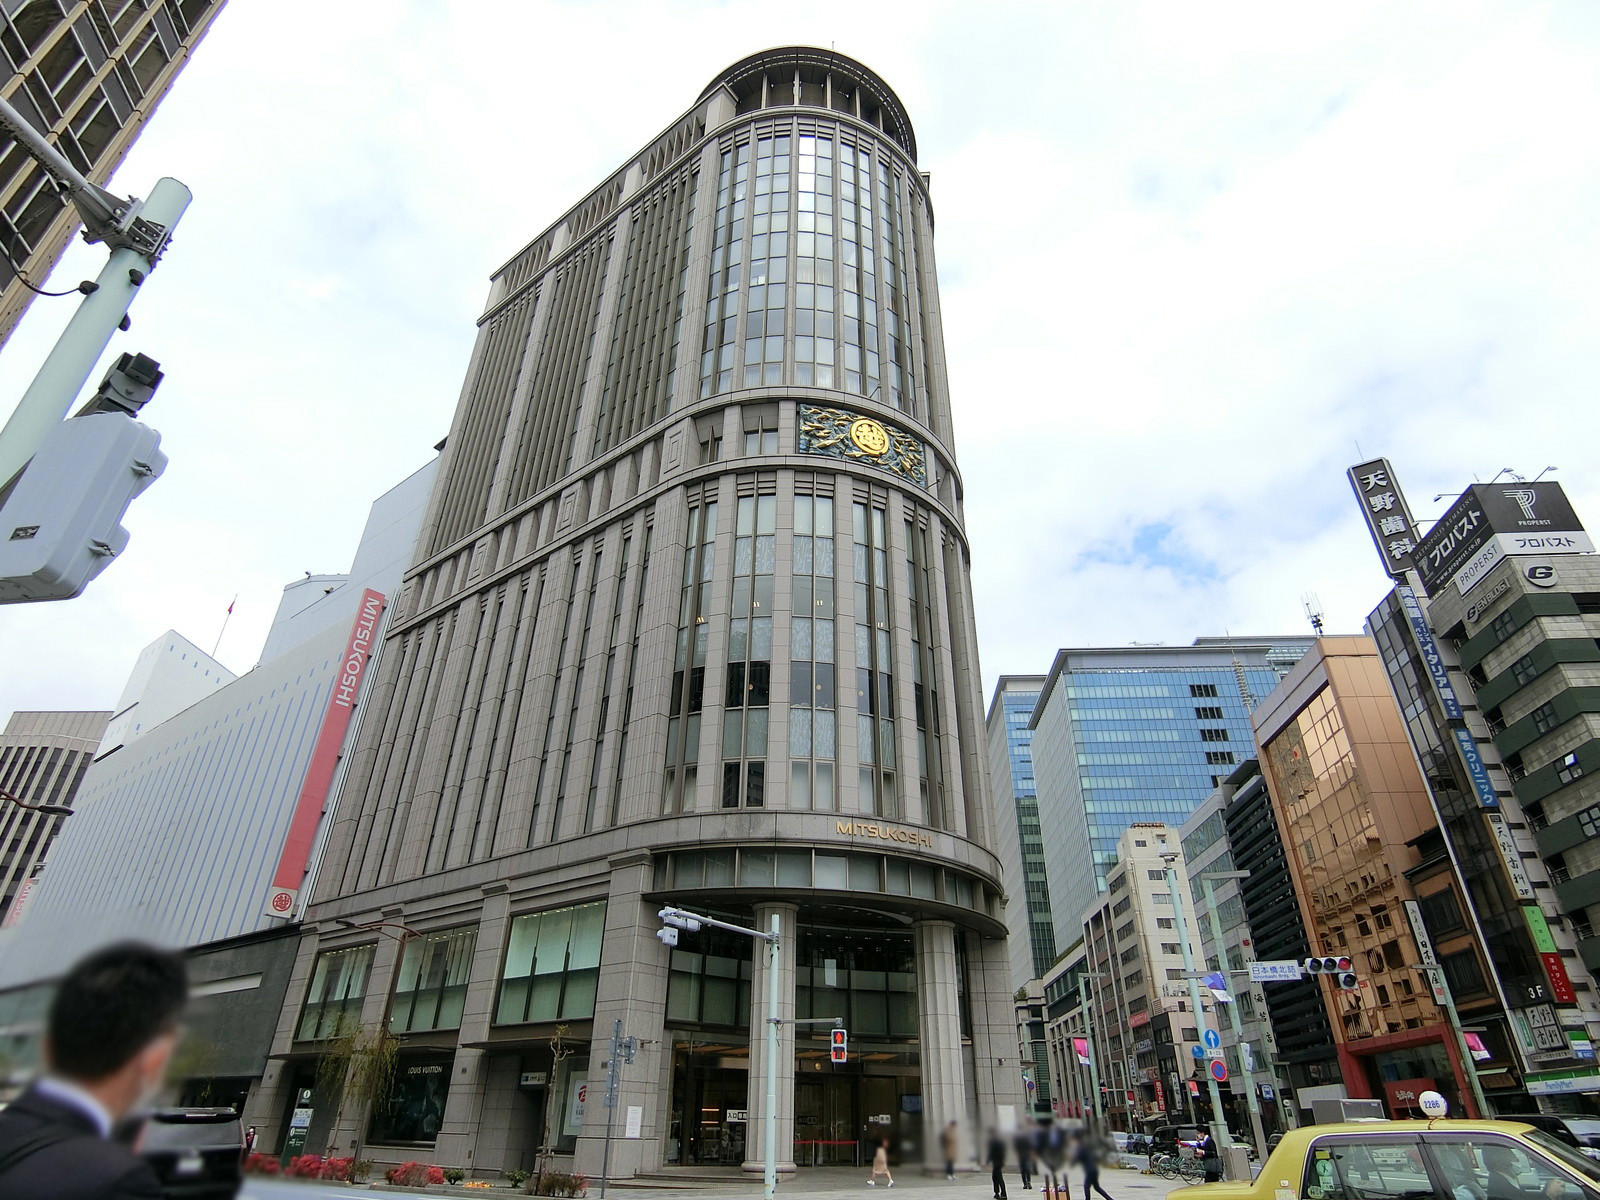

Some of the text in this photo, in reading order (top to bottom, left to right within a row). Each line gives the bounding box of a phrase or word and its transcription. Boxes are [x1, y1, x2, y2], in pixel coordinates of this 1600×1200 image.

[1360, 469, 1416, 560] 天野歯科
[1429, 510, 1480, 567] プロパスト
[1515, 537, 1576, 548] プロパスト
[1460, 544, 1498, 586] PROPERST
[335, 597, 380, 707] MITSUKOSHI
[836, 821, 932, 848] MITSUKOSHI
[1423, 1101, 1441, 1109] 2286
